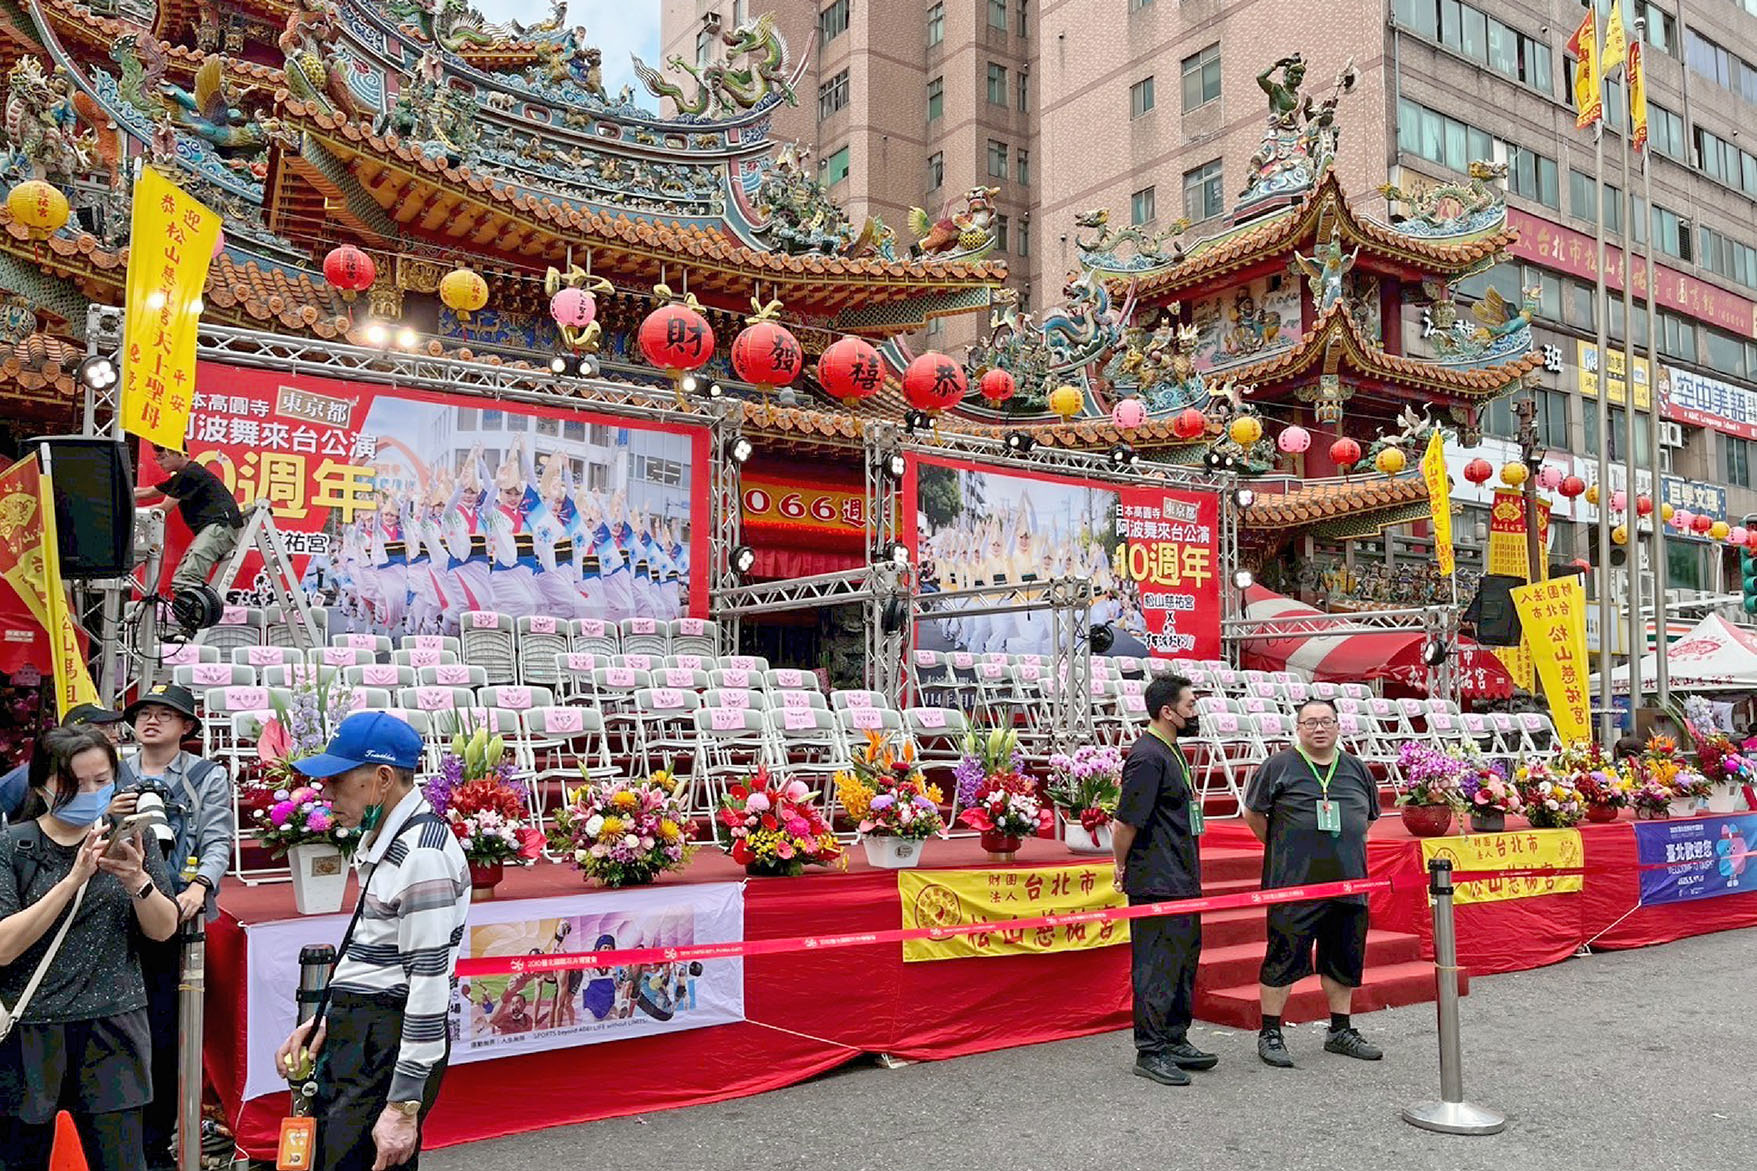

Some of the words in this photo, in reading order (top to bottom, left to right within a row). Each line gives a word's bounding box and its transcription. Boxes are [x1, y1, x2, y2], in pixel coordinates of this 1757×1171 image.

[665, 318, 708, 358] 財
[769, 333, 801, 375] 發
[850, 353, 881, 391] 禧
[930, 364, 962, 398] 恭
[170, 369, 188, 414] 平安
[192, 391, 270, 418] 本高圓寺
[283, 391, 349, 424] 東京都
[1676, 376, 1746, 422] 空中美語
[1116, 518, 1210, 544] 阿波舞來台公演
[1116, 542, 1212, 588] 10週年
[1145, 594, 1194, 609] 松山慈祐宮
[1496, 834, 1538, 856] 台北市
[988, 873, 1017, 886] 財團
[1025, 869, 1096, 901] 台北市
[989, 890, 1018, 903] 法人
